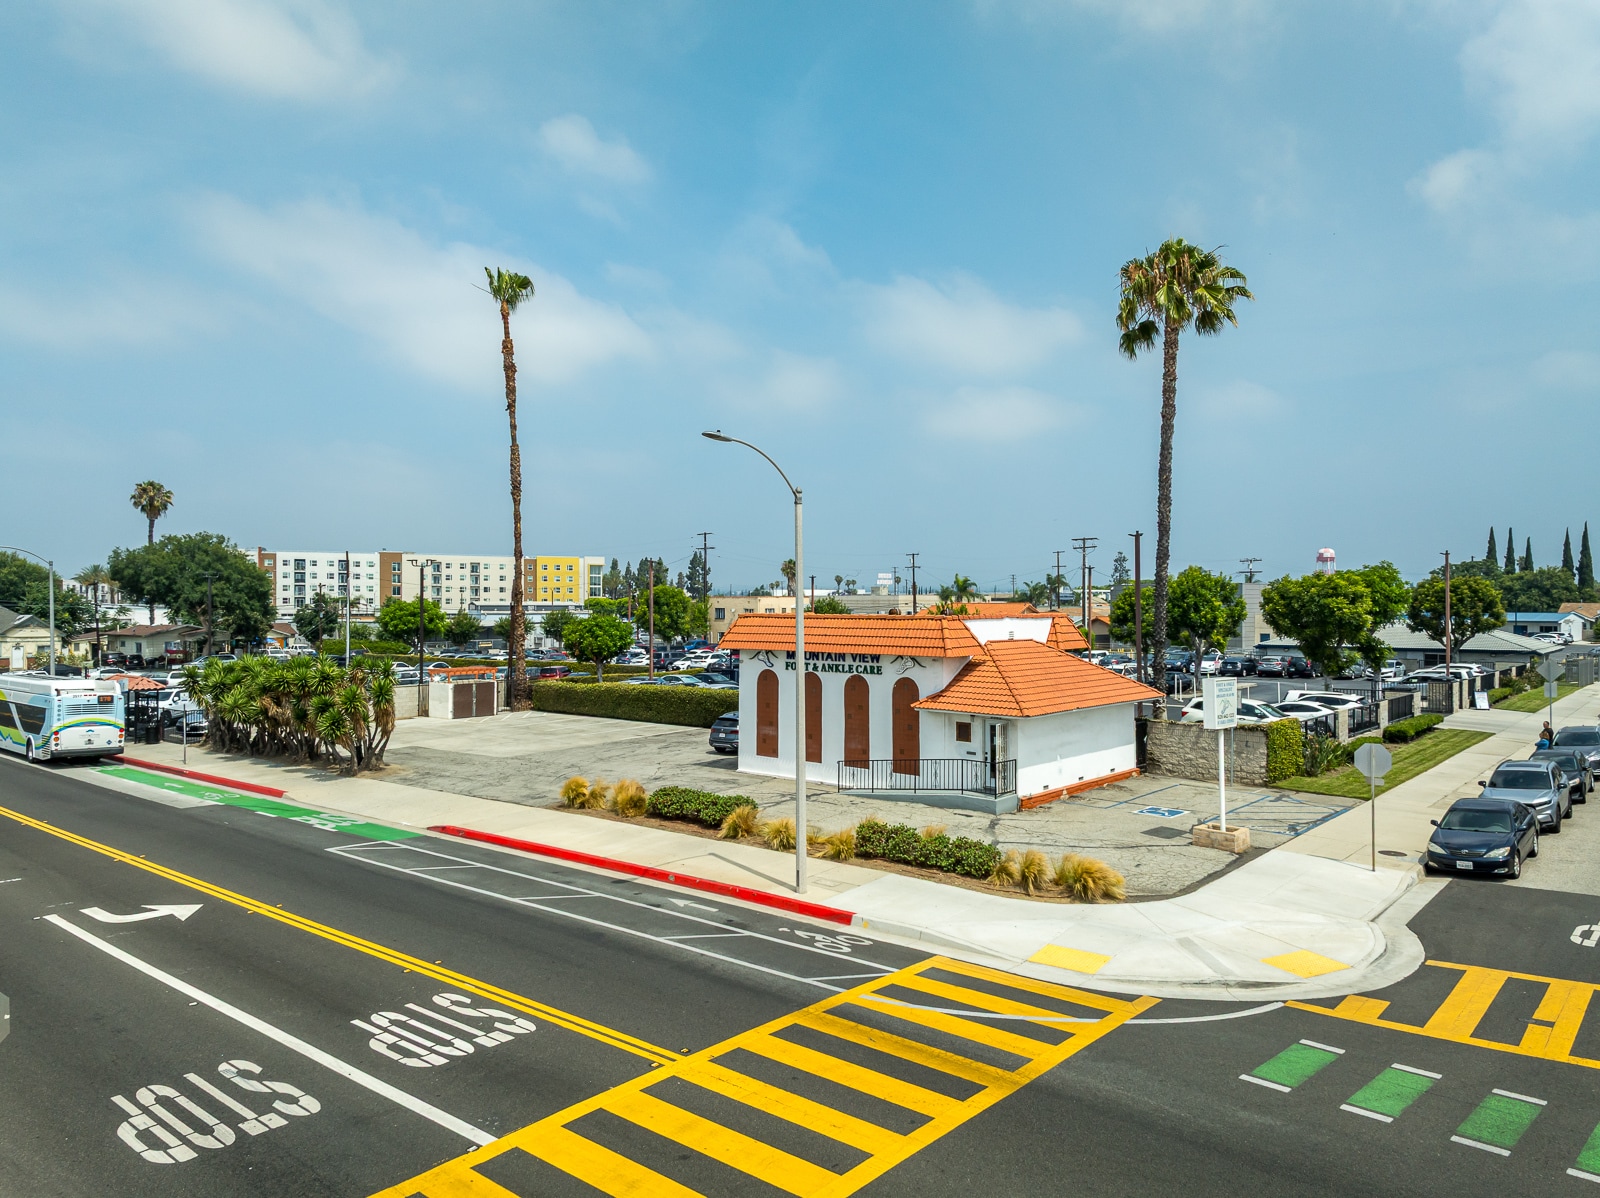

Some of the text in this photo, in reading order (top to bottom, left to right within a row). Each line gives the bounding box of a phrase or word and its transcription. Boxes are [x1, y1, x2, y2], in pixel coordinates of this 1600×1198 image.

[785, 661, 883, 675] FOT & ANKLE CARE
[786, 651, 881, 663] MUNTAIN VIEW
[350, 993, 537, 1067] STOP
[110, 1059, 321, 1164] STOP
